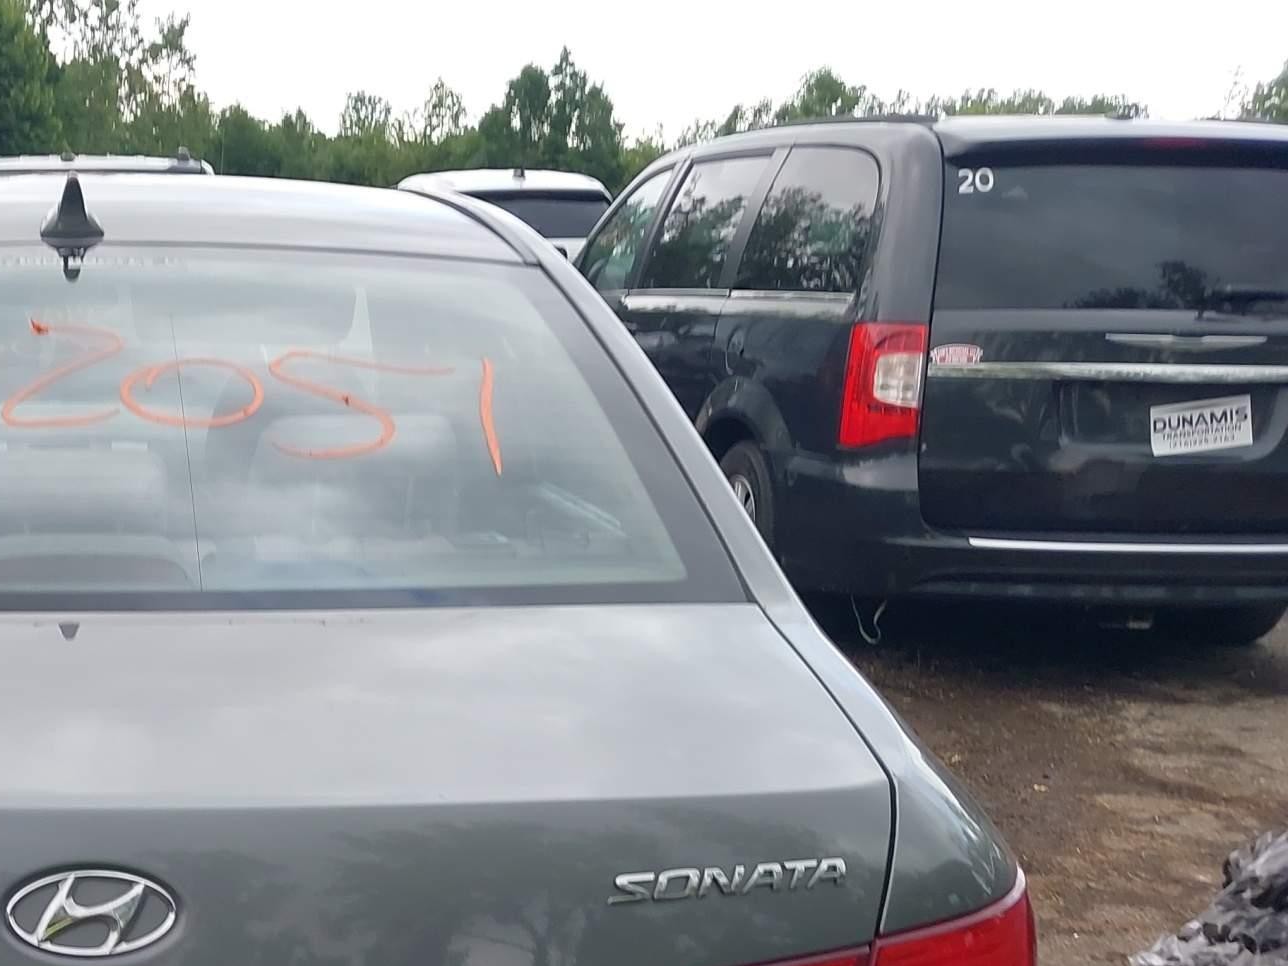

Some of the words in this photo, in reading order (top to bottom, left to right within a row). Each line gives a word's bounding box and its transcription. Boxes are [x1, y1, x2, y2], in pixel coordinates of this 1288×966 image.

[958, 167, 994, 194] 20
[1153, 406, 1249, 434] DUNAMIS
[1162, 421, 1243, 442] TRANSPORTATION
[607, 857, 847, 905] SONATA
